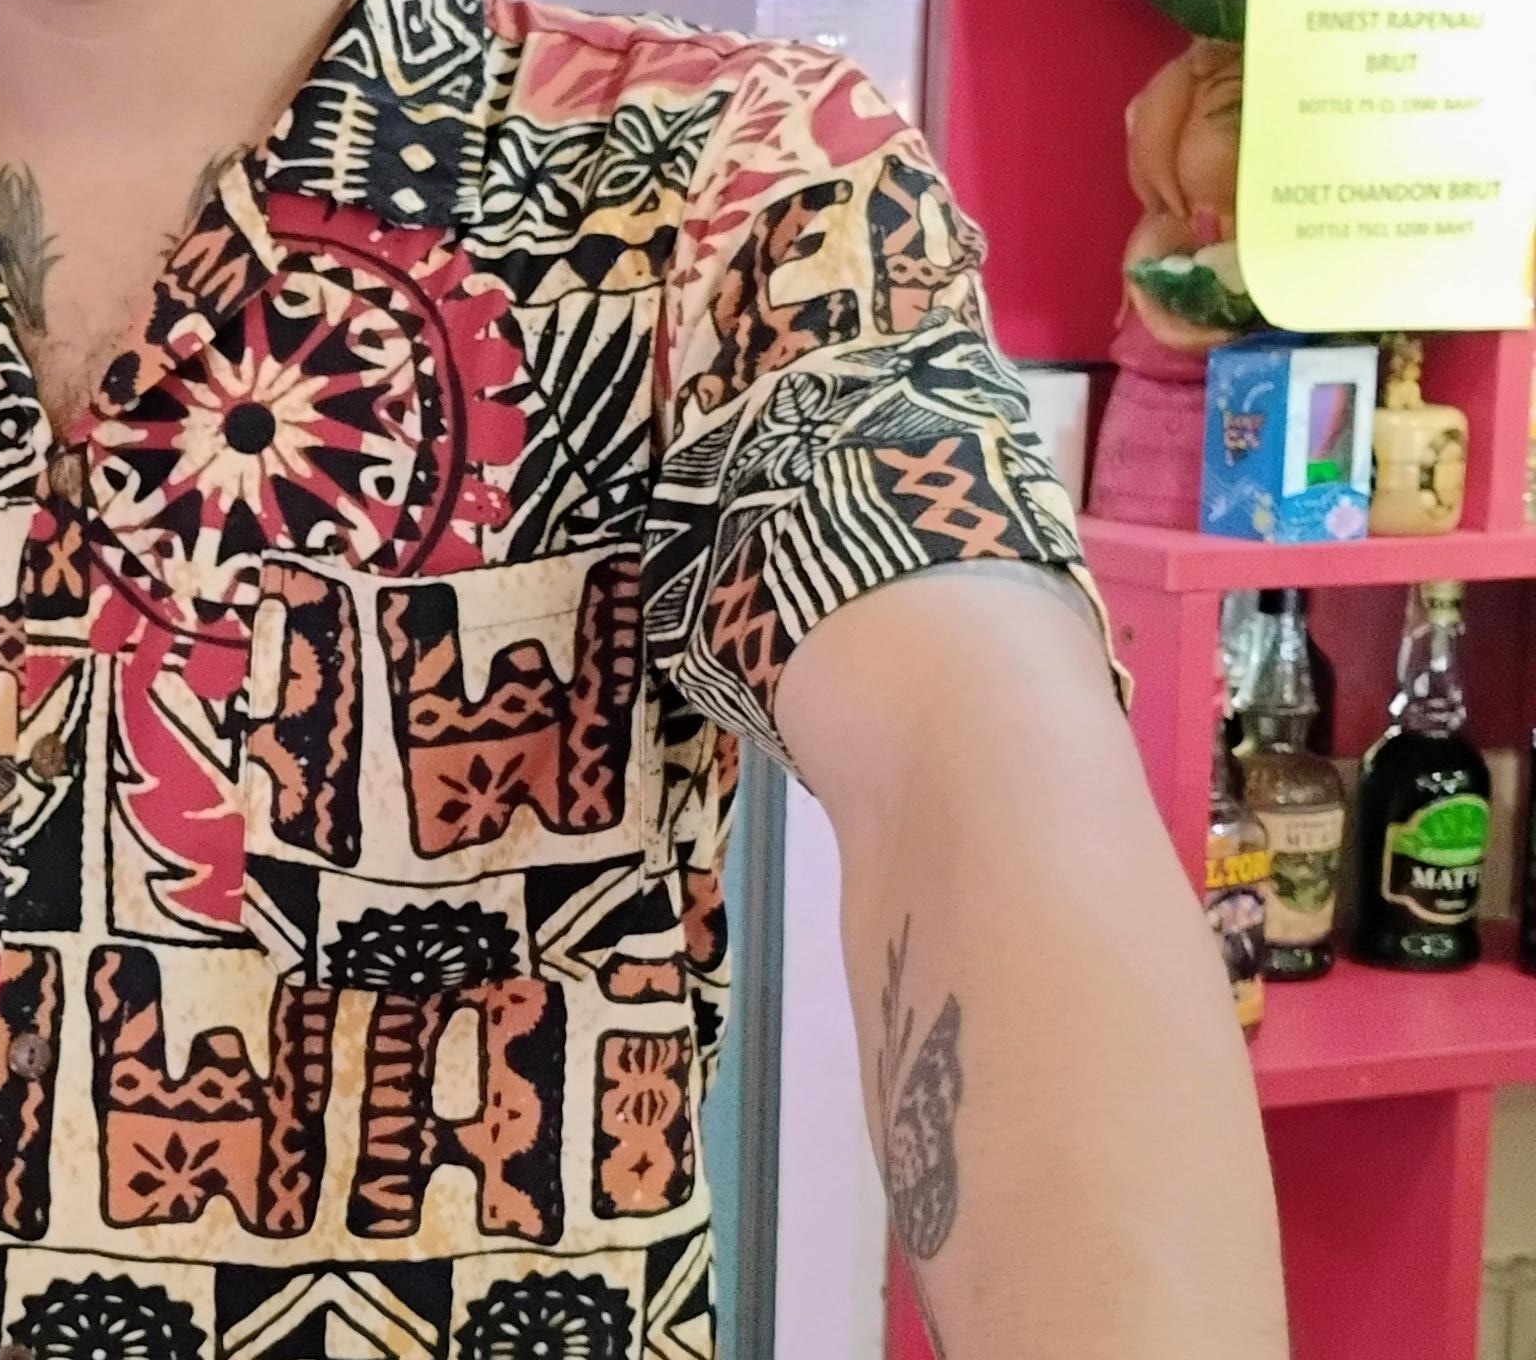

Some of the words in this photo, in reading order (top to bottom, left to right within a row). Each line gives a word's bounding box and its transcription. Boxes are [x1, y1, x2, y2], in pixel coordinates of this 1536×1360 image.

[1305, 11, 1379, 31] ERNEST
[1365, 53, 1417, 73] BRUT
[1271, 184, 1331, 204] MOET
[1337, 184, 1441, 203] CHANDON
[1447, 180, 1501, 200] BRUT
